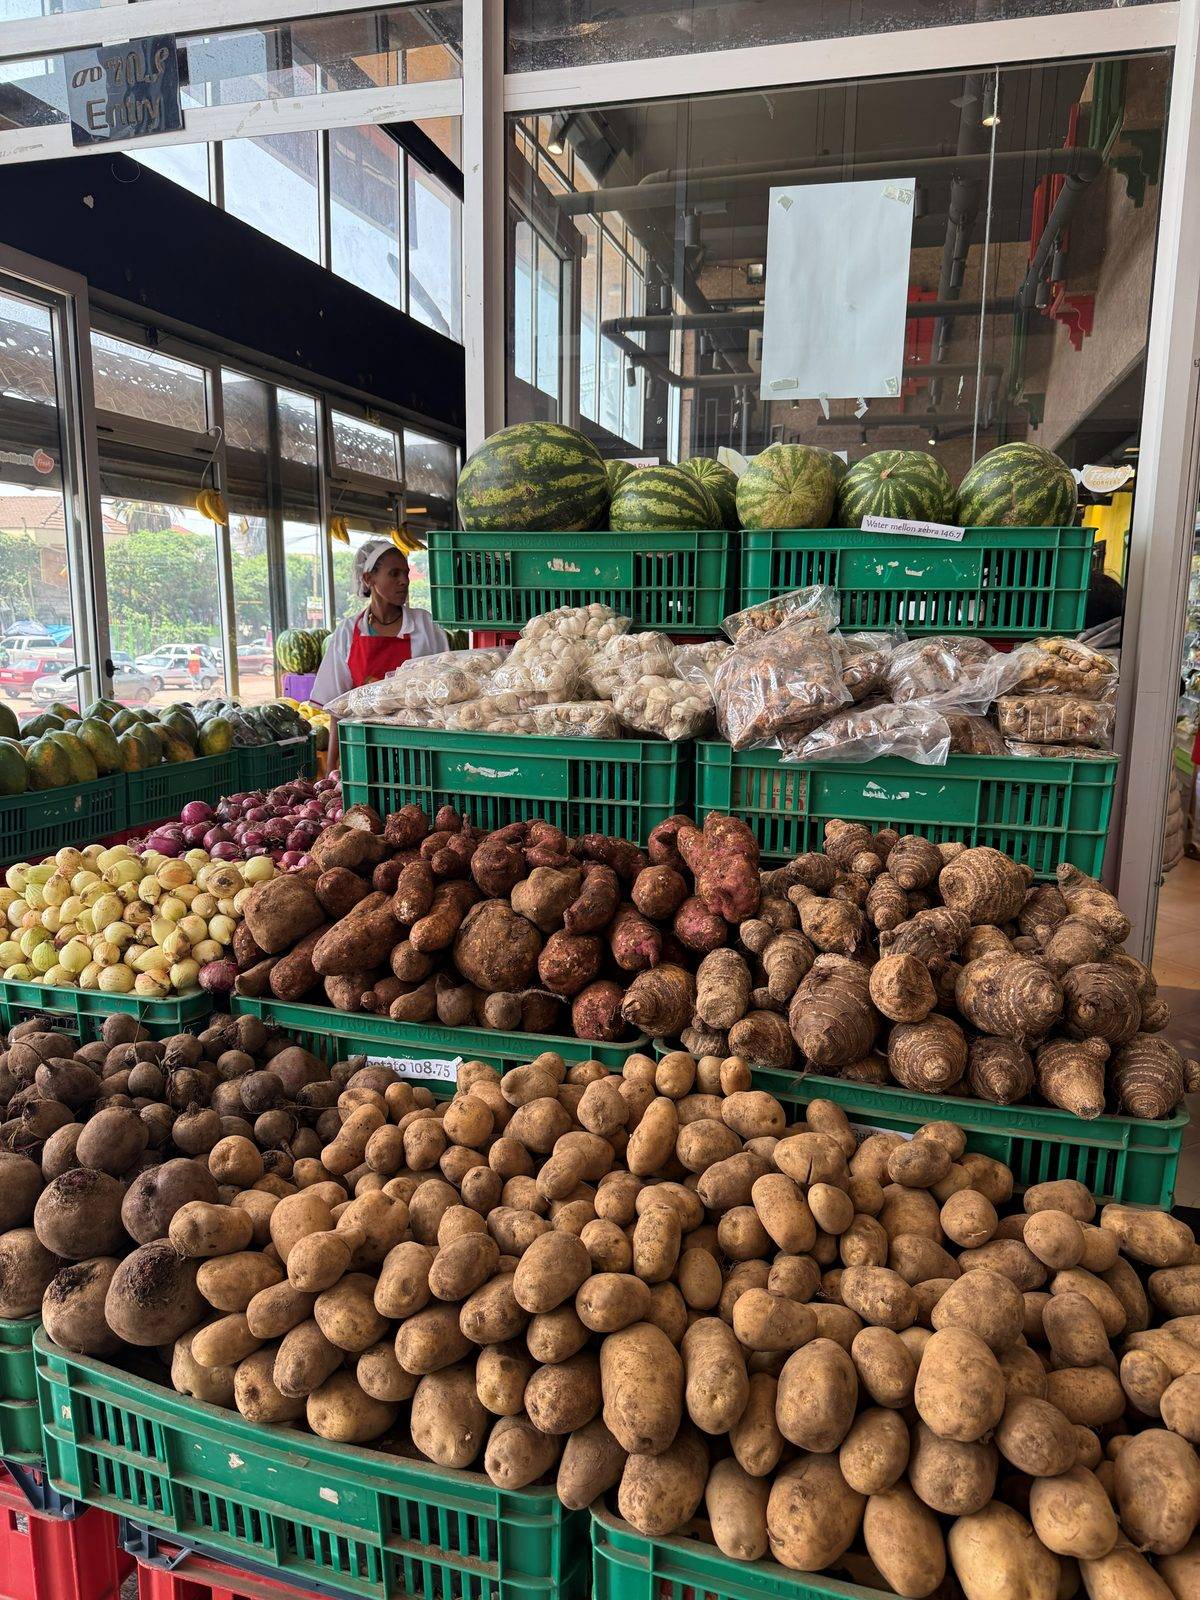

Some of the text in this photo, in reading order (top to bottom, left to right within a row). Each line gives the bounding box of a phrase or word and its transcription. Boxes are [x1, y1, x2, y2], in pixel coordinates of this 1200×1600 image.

[866, 519, 962, 539] Water mellon zebra 146.7
[410, 1061, 451, 1078] 108.75
